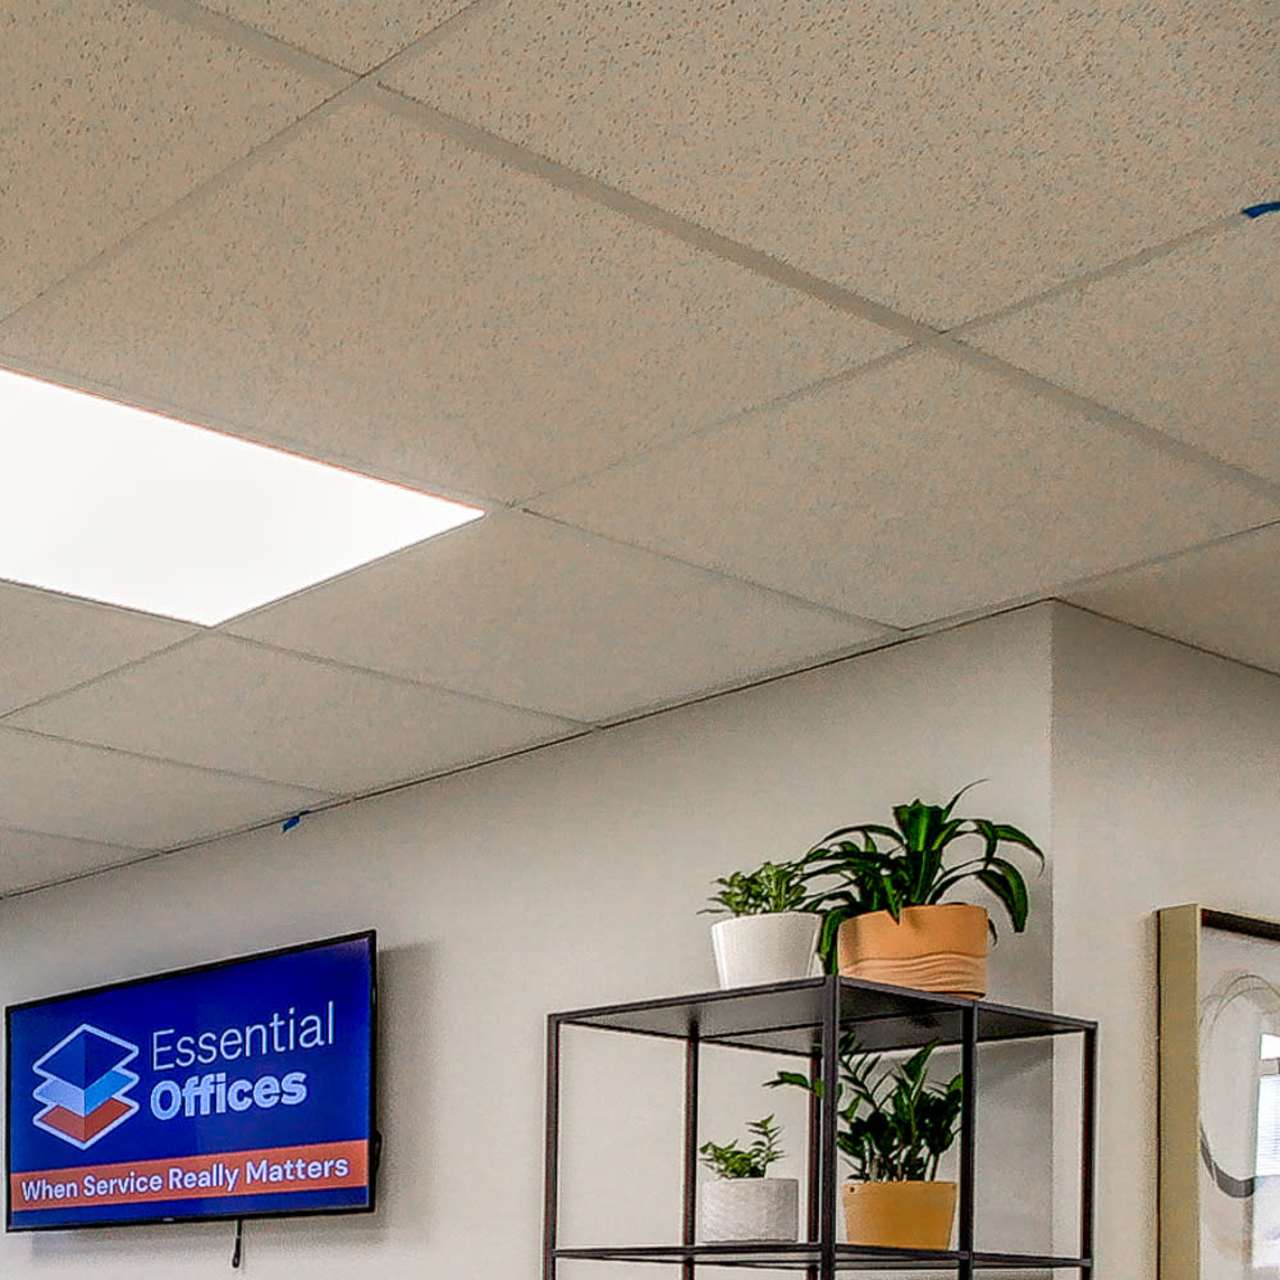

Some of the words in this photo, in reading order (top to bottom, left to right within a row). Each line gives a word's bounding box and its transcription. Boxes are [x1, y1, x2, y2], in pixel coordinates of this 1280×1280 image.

[152, 1001, 334, 1071] Essential
[150, 1070, 307, 1120] Offices
[22, 1179, 79, 1201] When
[83, 1172, 162, 1196] Service
[168, 1163, 240, 1192] Really
[245, 1158, 348, 1184] Matters
